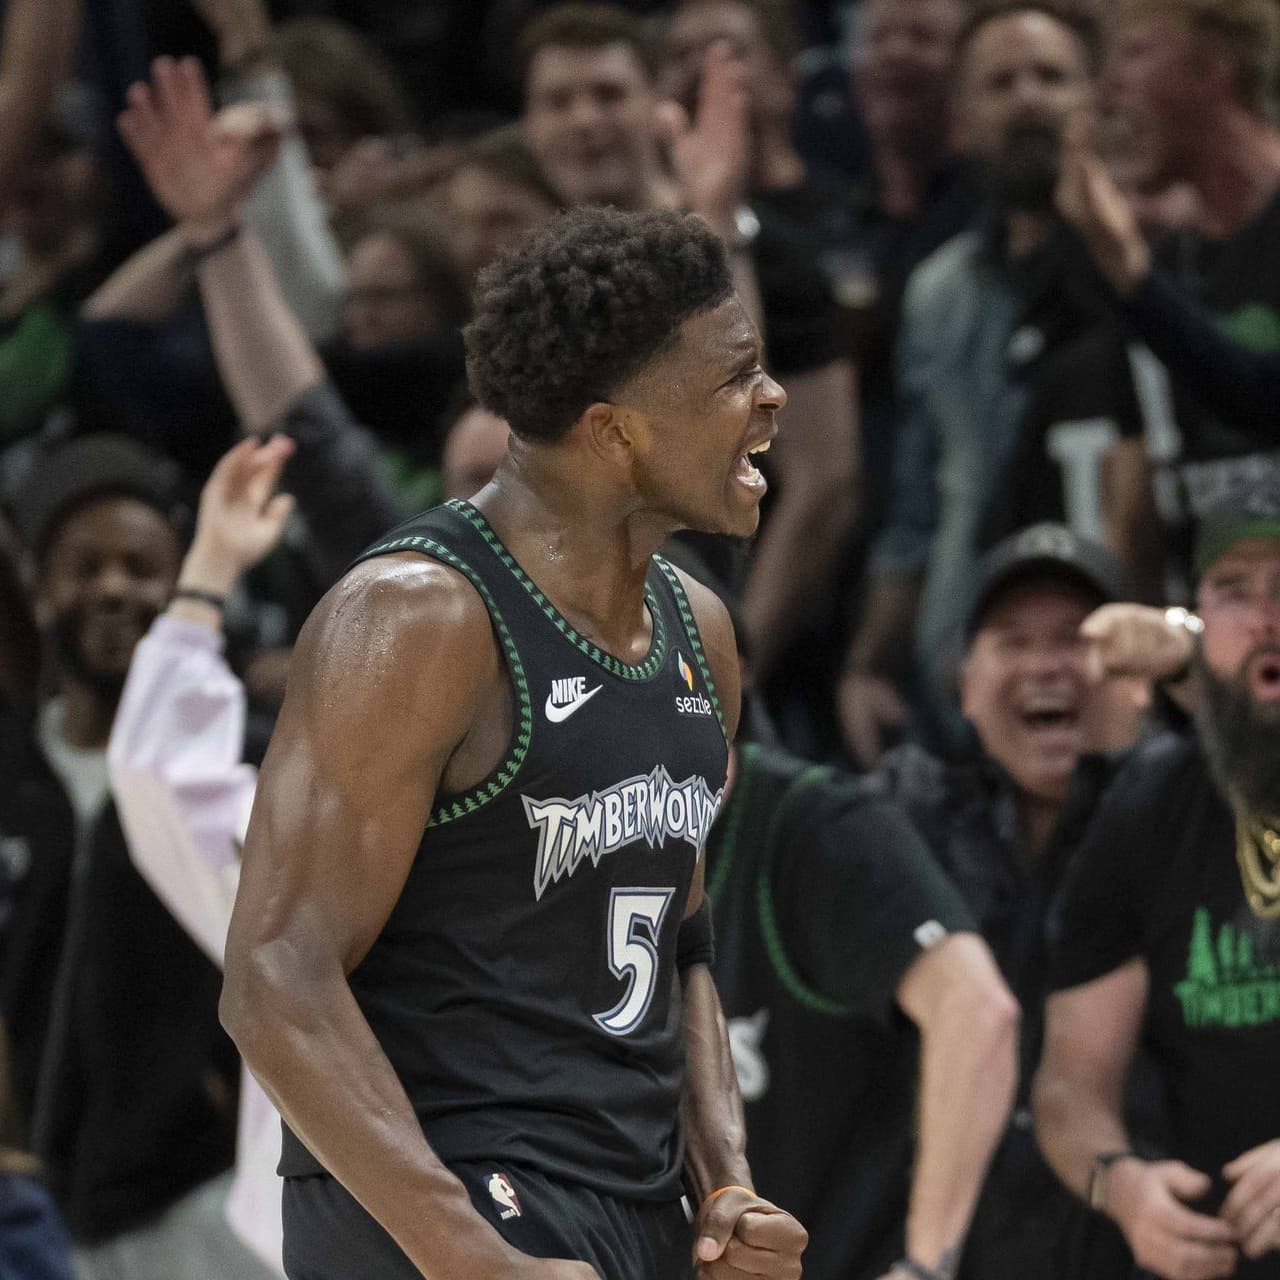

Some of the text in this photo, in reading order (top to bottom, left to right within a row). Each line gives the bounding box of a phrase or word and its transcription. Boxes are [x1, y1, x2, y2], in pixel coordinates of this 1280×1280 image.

[551, 676, 586, 704] NIKE
[675, 692, 711, 716] sezzle
[591, 887, 676, 1036] 5
